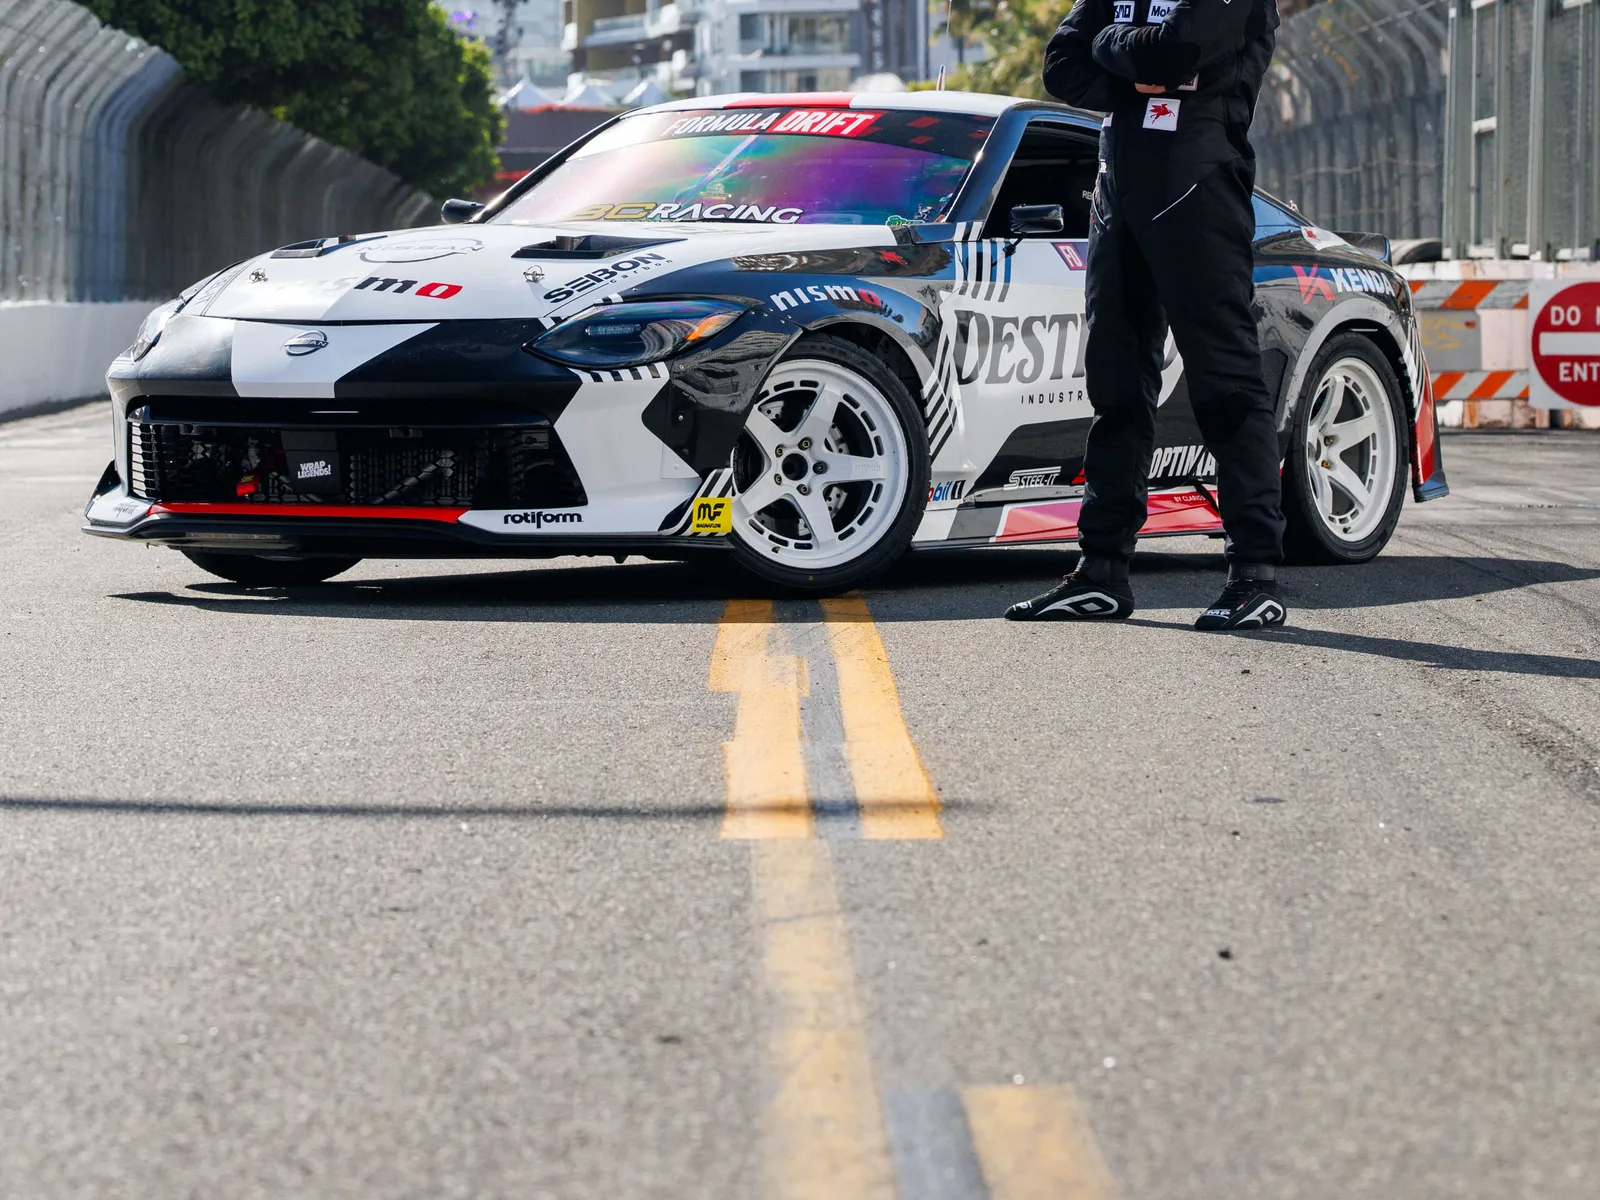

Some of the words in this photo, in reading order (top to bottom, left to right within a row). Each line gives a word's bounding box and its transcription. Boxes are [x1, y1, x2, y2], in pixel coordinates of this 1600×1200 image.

[662, 112, 781, 136] FORMULA
[773, 111, 875, 135] DRIFT
[543, 252, 667, 303] SEIBON
[609, 259, 673, 284] carbon
[1329, 268, 1395, 297] KENDA
[1550, 305, 1580, 326] DO
[953, 310, 1087, 385] DESTI
[1559, 362, 1600, 382] ENT
[1021, 390, 1087, 404] INDUSTR
[298, 464, 331, 478] LEGENDS!
[300, 460, 326, 471] WRAP
[1148, 445, 1216, 479] OPTIMA
[1020, 474, 1059, 488] STEEL-IT
[504, 511, 583, 529] rotiform
[698, 503, 725, 521] MF
